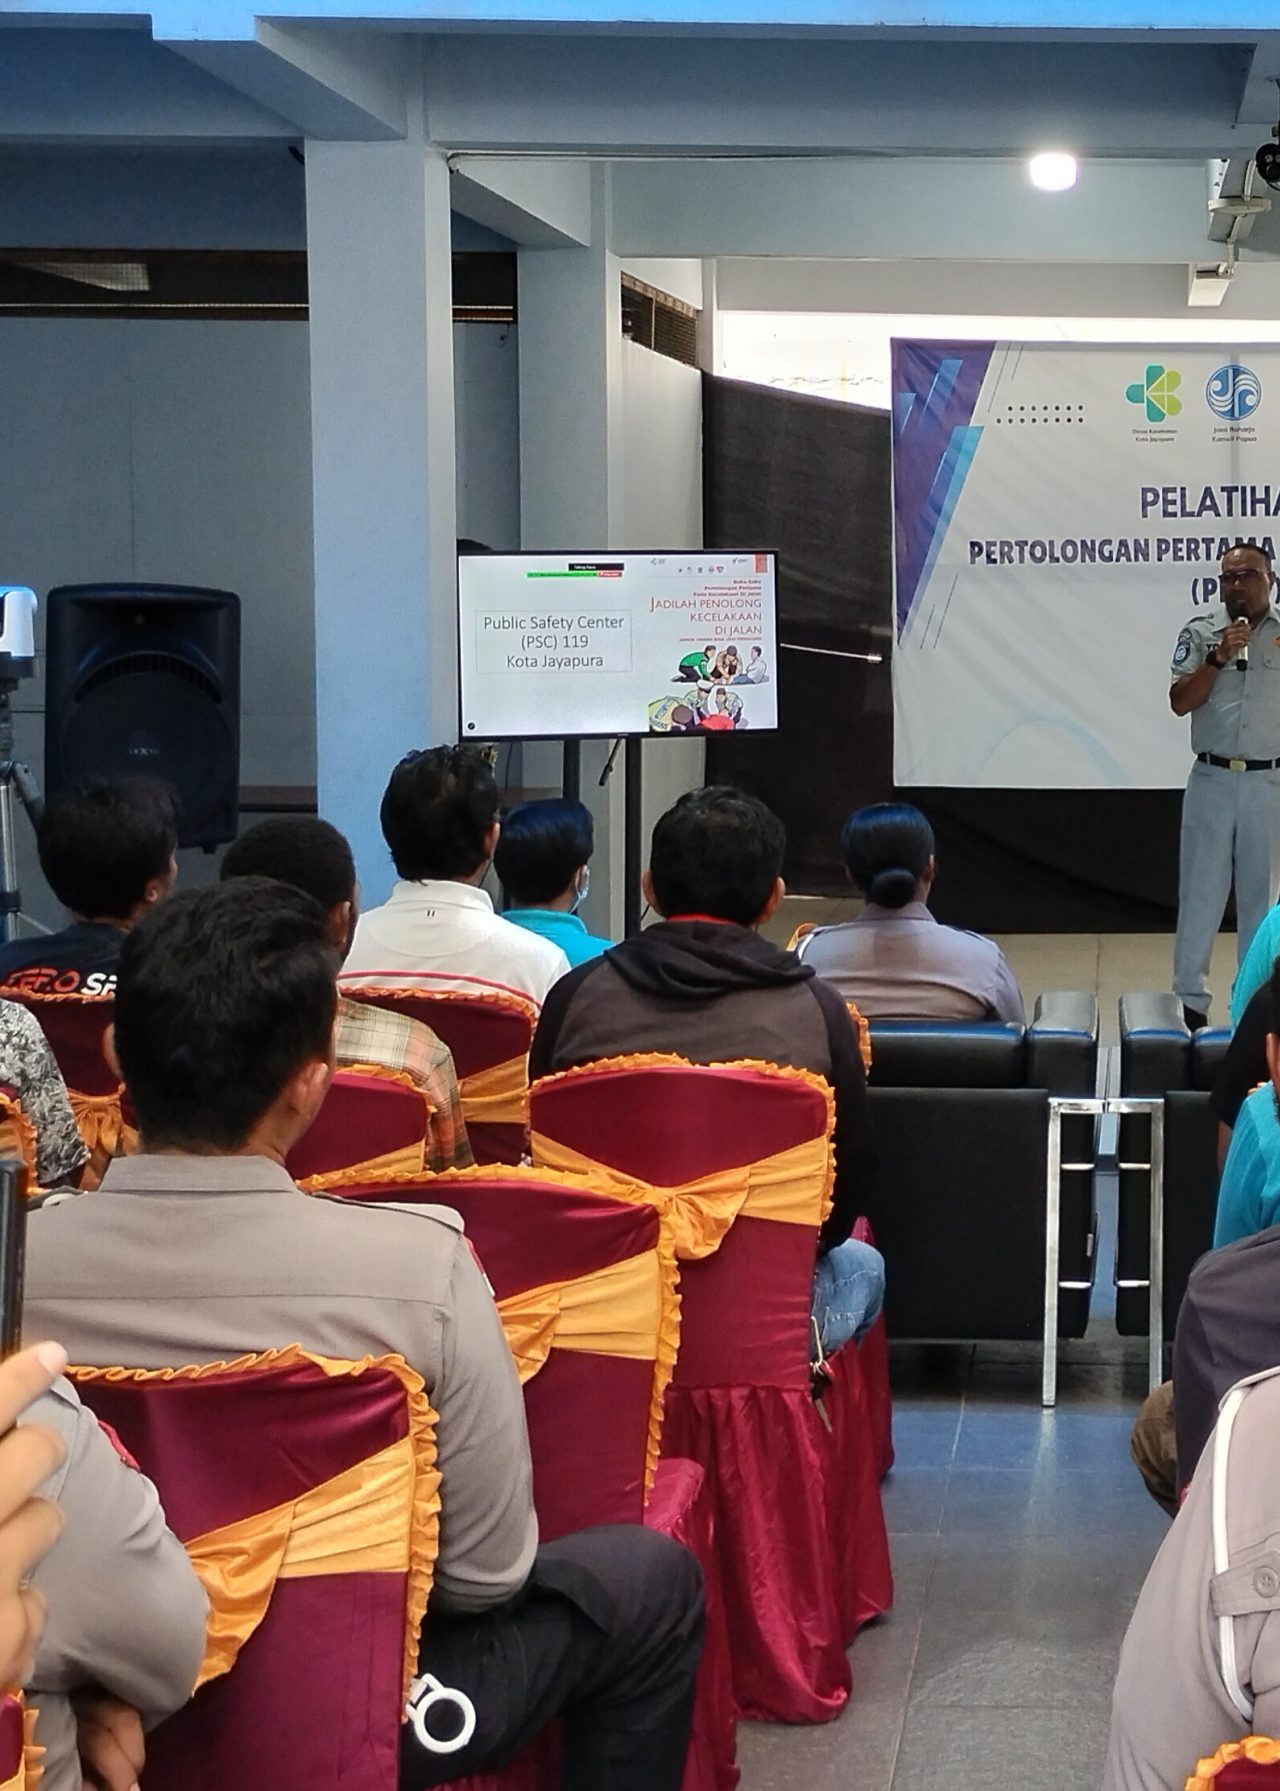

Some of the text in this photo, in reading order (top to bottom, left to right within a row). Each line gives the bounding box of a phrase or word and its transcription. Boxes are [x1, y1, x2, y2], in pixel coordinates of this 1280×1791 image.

[969, 537, 1150, 565] PERTOLONGAN
[650, 597, 762, 613] JADILAH PENOLONG
[484, 615, 624, 631] Public Safety Center
[690, 612, 762, 622] KECELAKAAN
[715, 625, 763, 637] DI JALAN
[521, 635, 589, 651] (PSC) 119
[507, 655, 604, 670] Kota Jayapura
